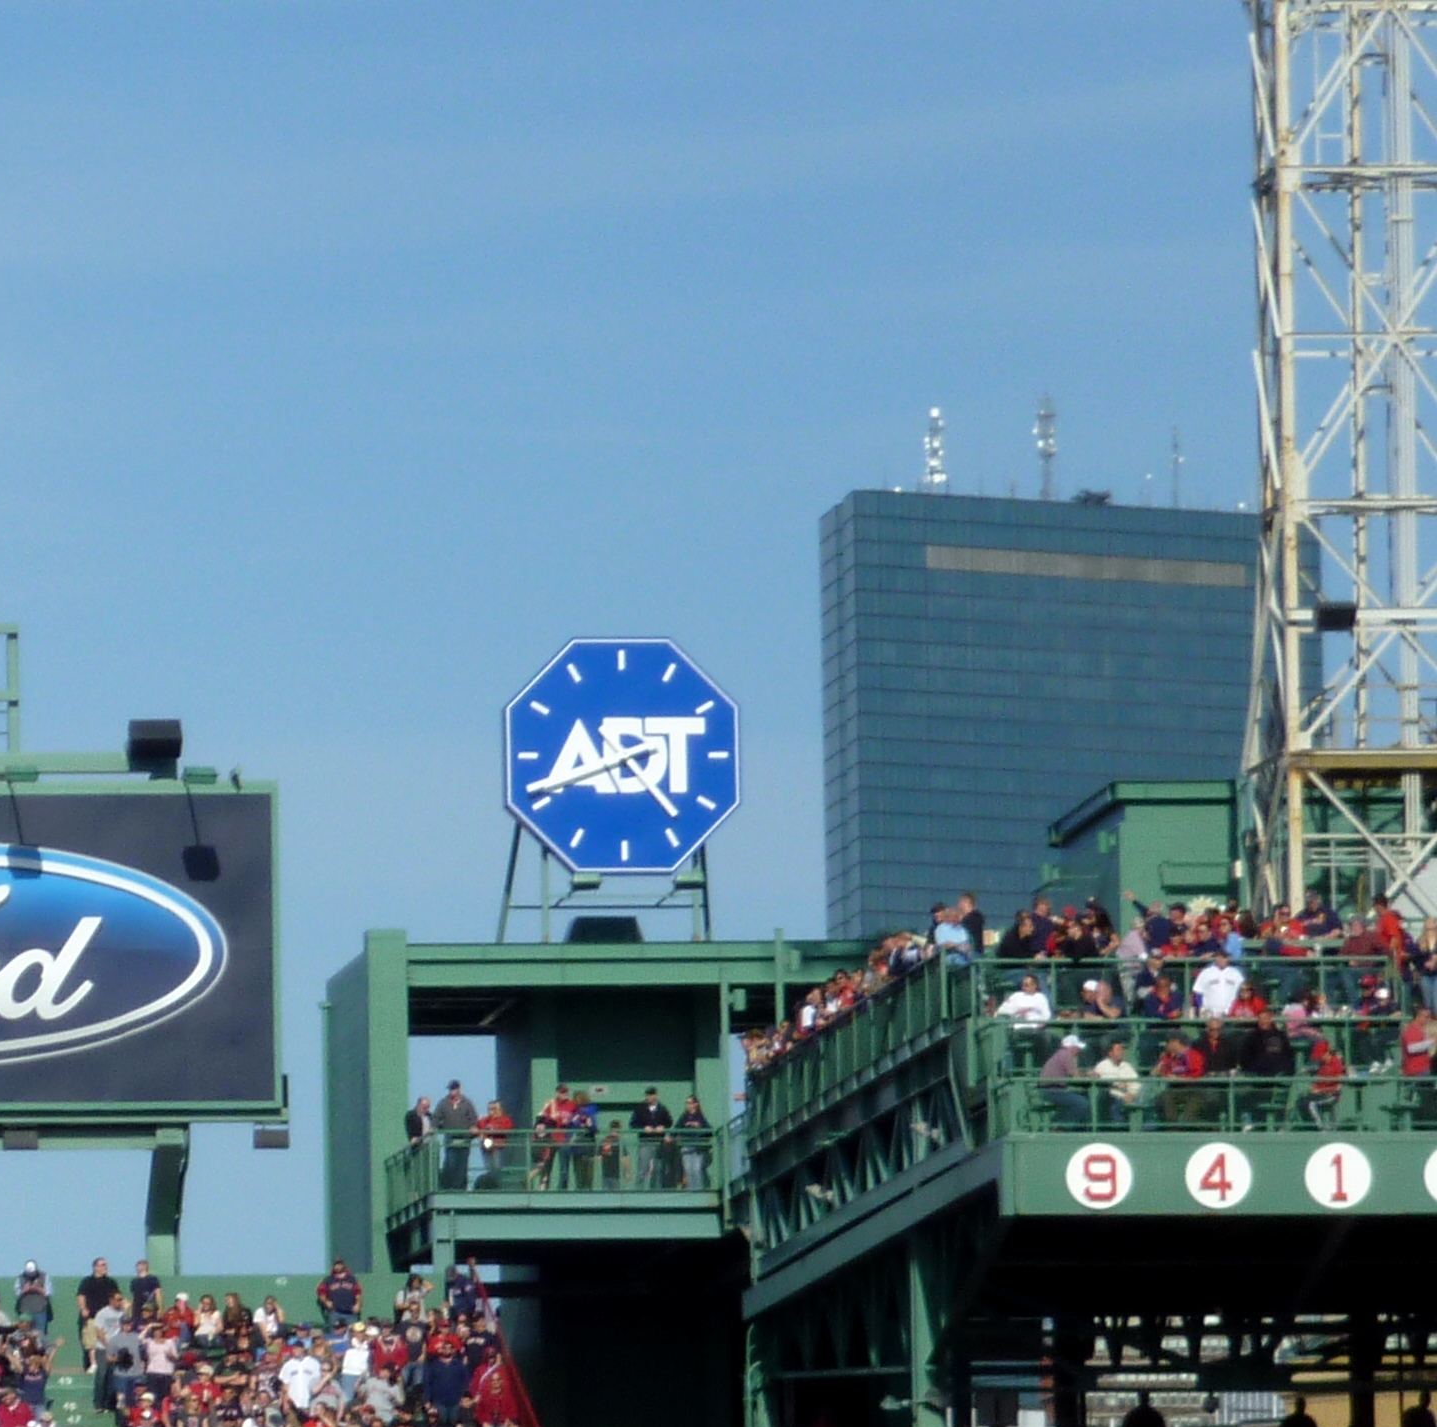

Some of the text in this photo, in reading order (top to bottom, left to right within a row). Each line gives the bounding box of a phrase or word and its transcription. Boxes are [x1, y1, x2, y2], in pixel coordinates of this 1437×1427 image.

[546, 716, 706, 795] ADT
[1083, 1152, 1348, 1202] 9 4 1
